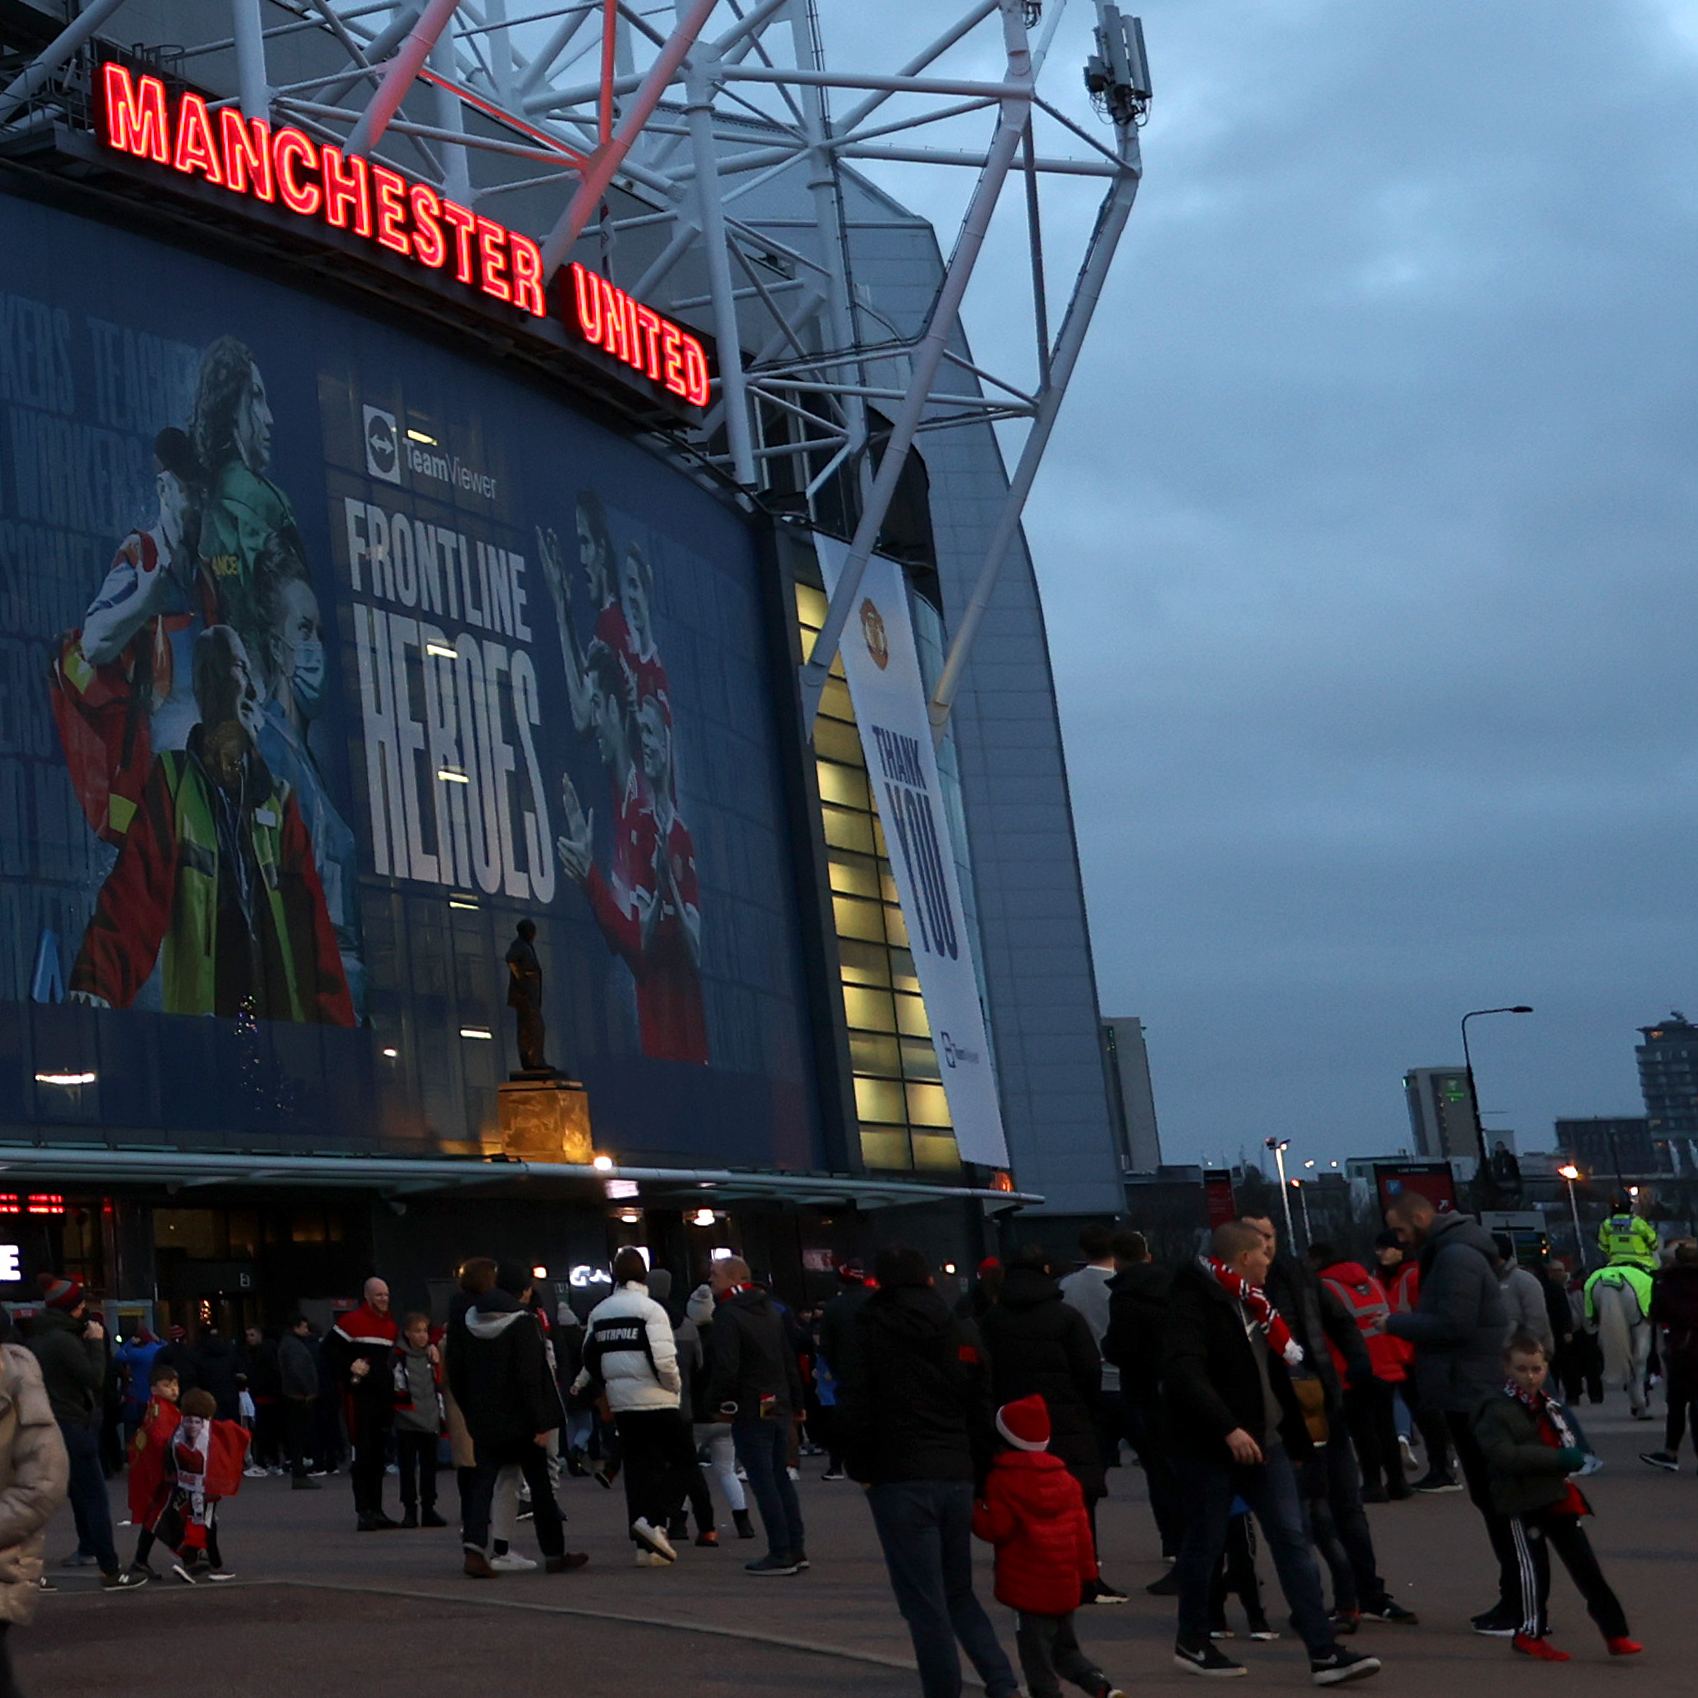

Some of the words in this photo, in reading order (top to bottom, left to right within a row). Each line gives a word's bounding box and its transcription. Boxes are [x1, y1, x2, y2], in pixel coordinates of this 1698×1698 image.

[102, 60, 545, 318] MANCHESTER
[569, 262, 709, 407] UNITED
[403, 437, 497, 500] TeamViewer
[344, 497, 532, 642] FRONTLINE
[352, 602, 555, 903] HEROES
[871, 725, 927, 790] THANK
[884, 782, 958, 961] YOU
